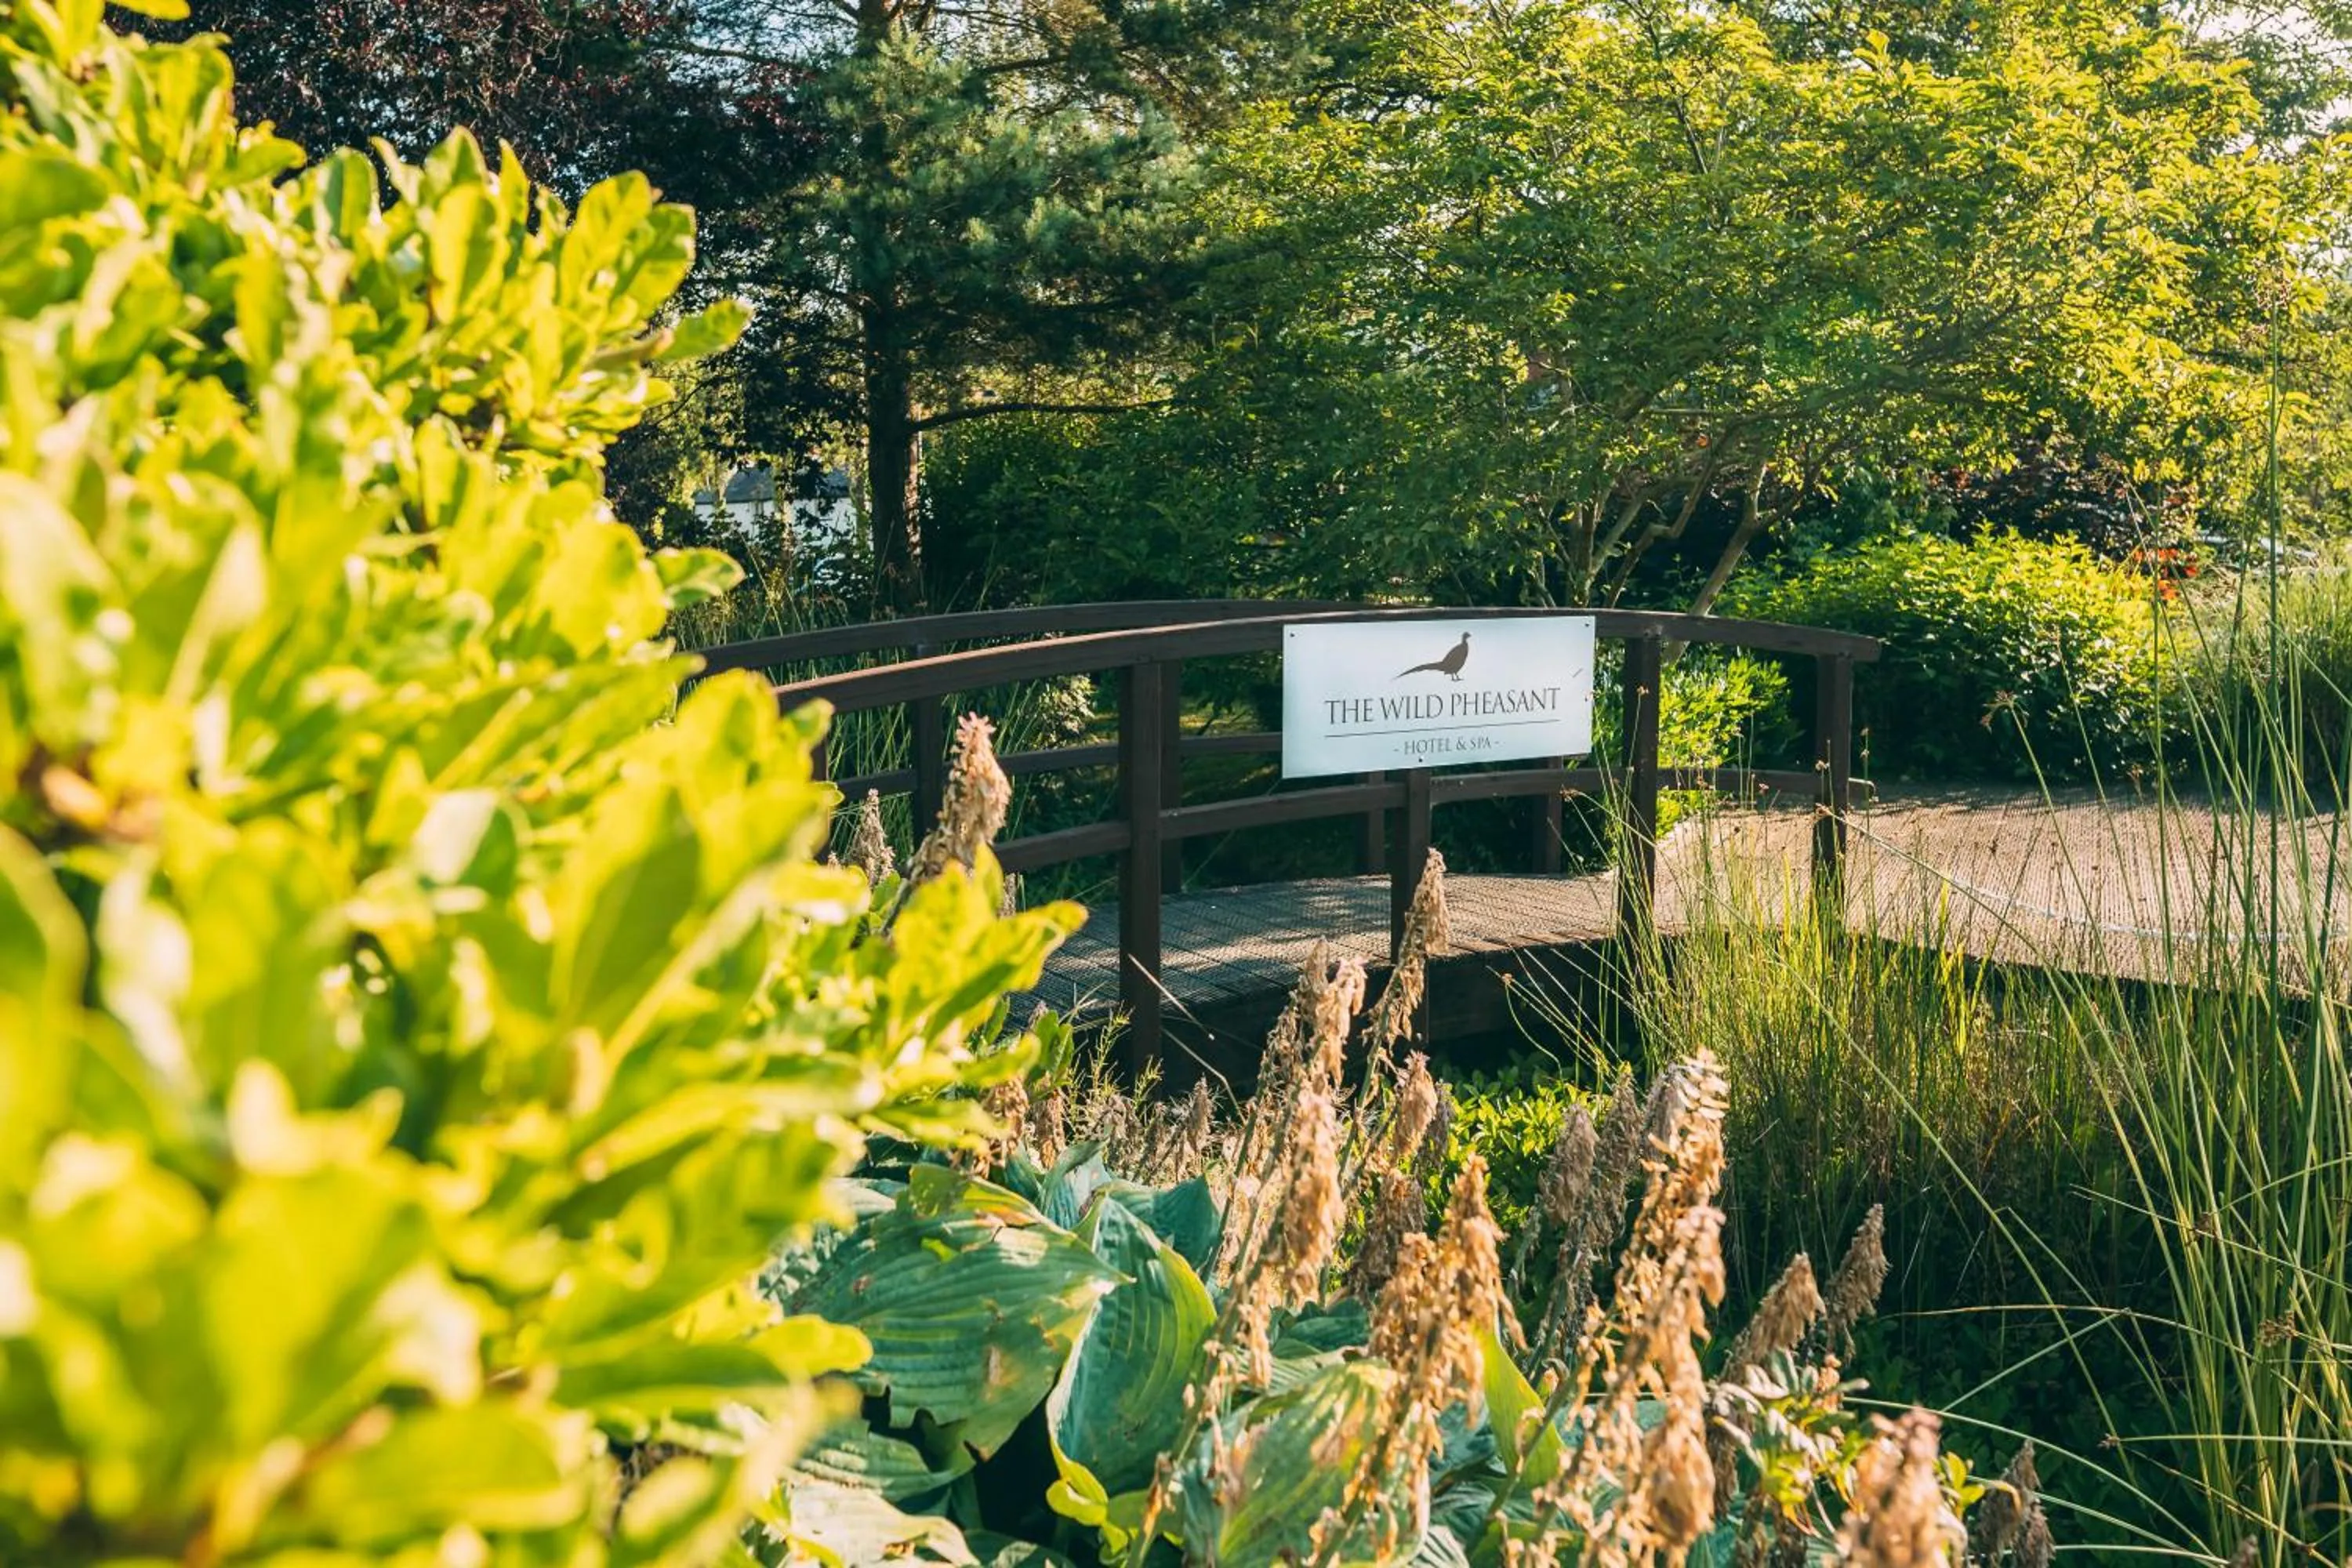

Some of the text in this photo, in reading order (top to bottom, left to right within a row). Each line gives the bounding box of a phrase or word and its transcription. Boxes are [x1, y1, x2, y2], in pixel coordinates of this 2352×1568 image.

[1325, 688, 1561, 724] THE WILD PHEASANT
[1403, 738, 1451, 755] HOTEL
[1456, 739, 1467, 750] &
[1470, 737, 1492, 750] SPA
